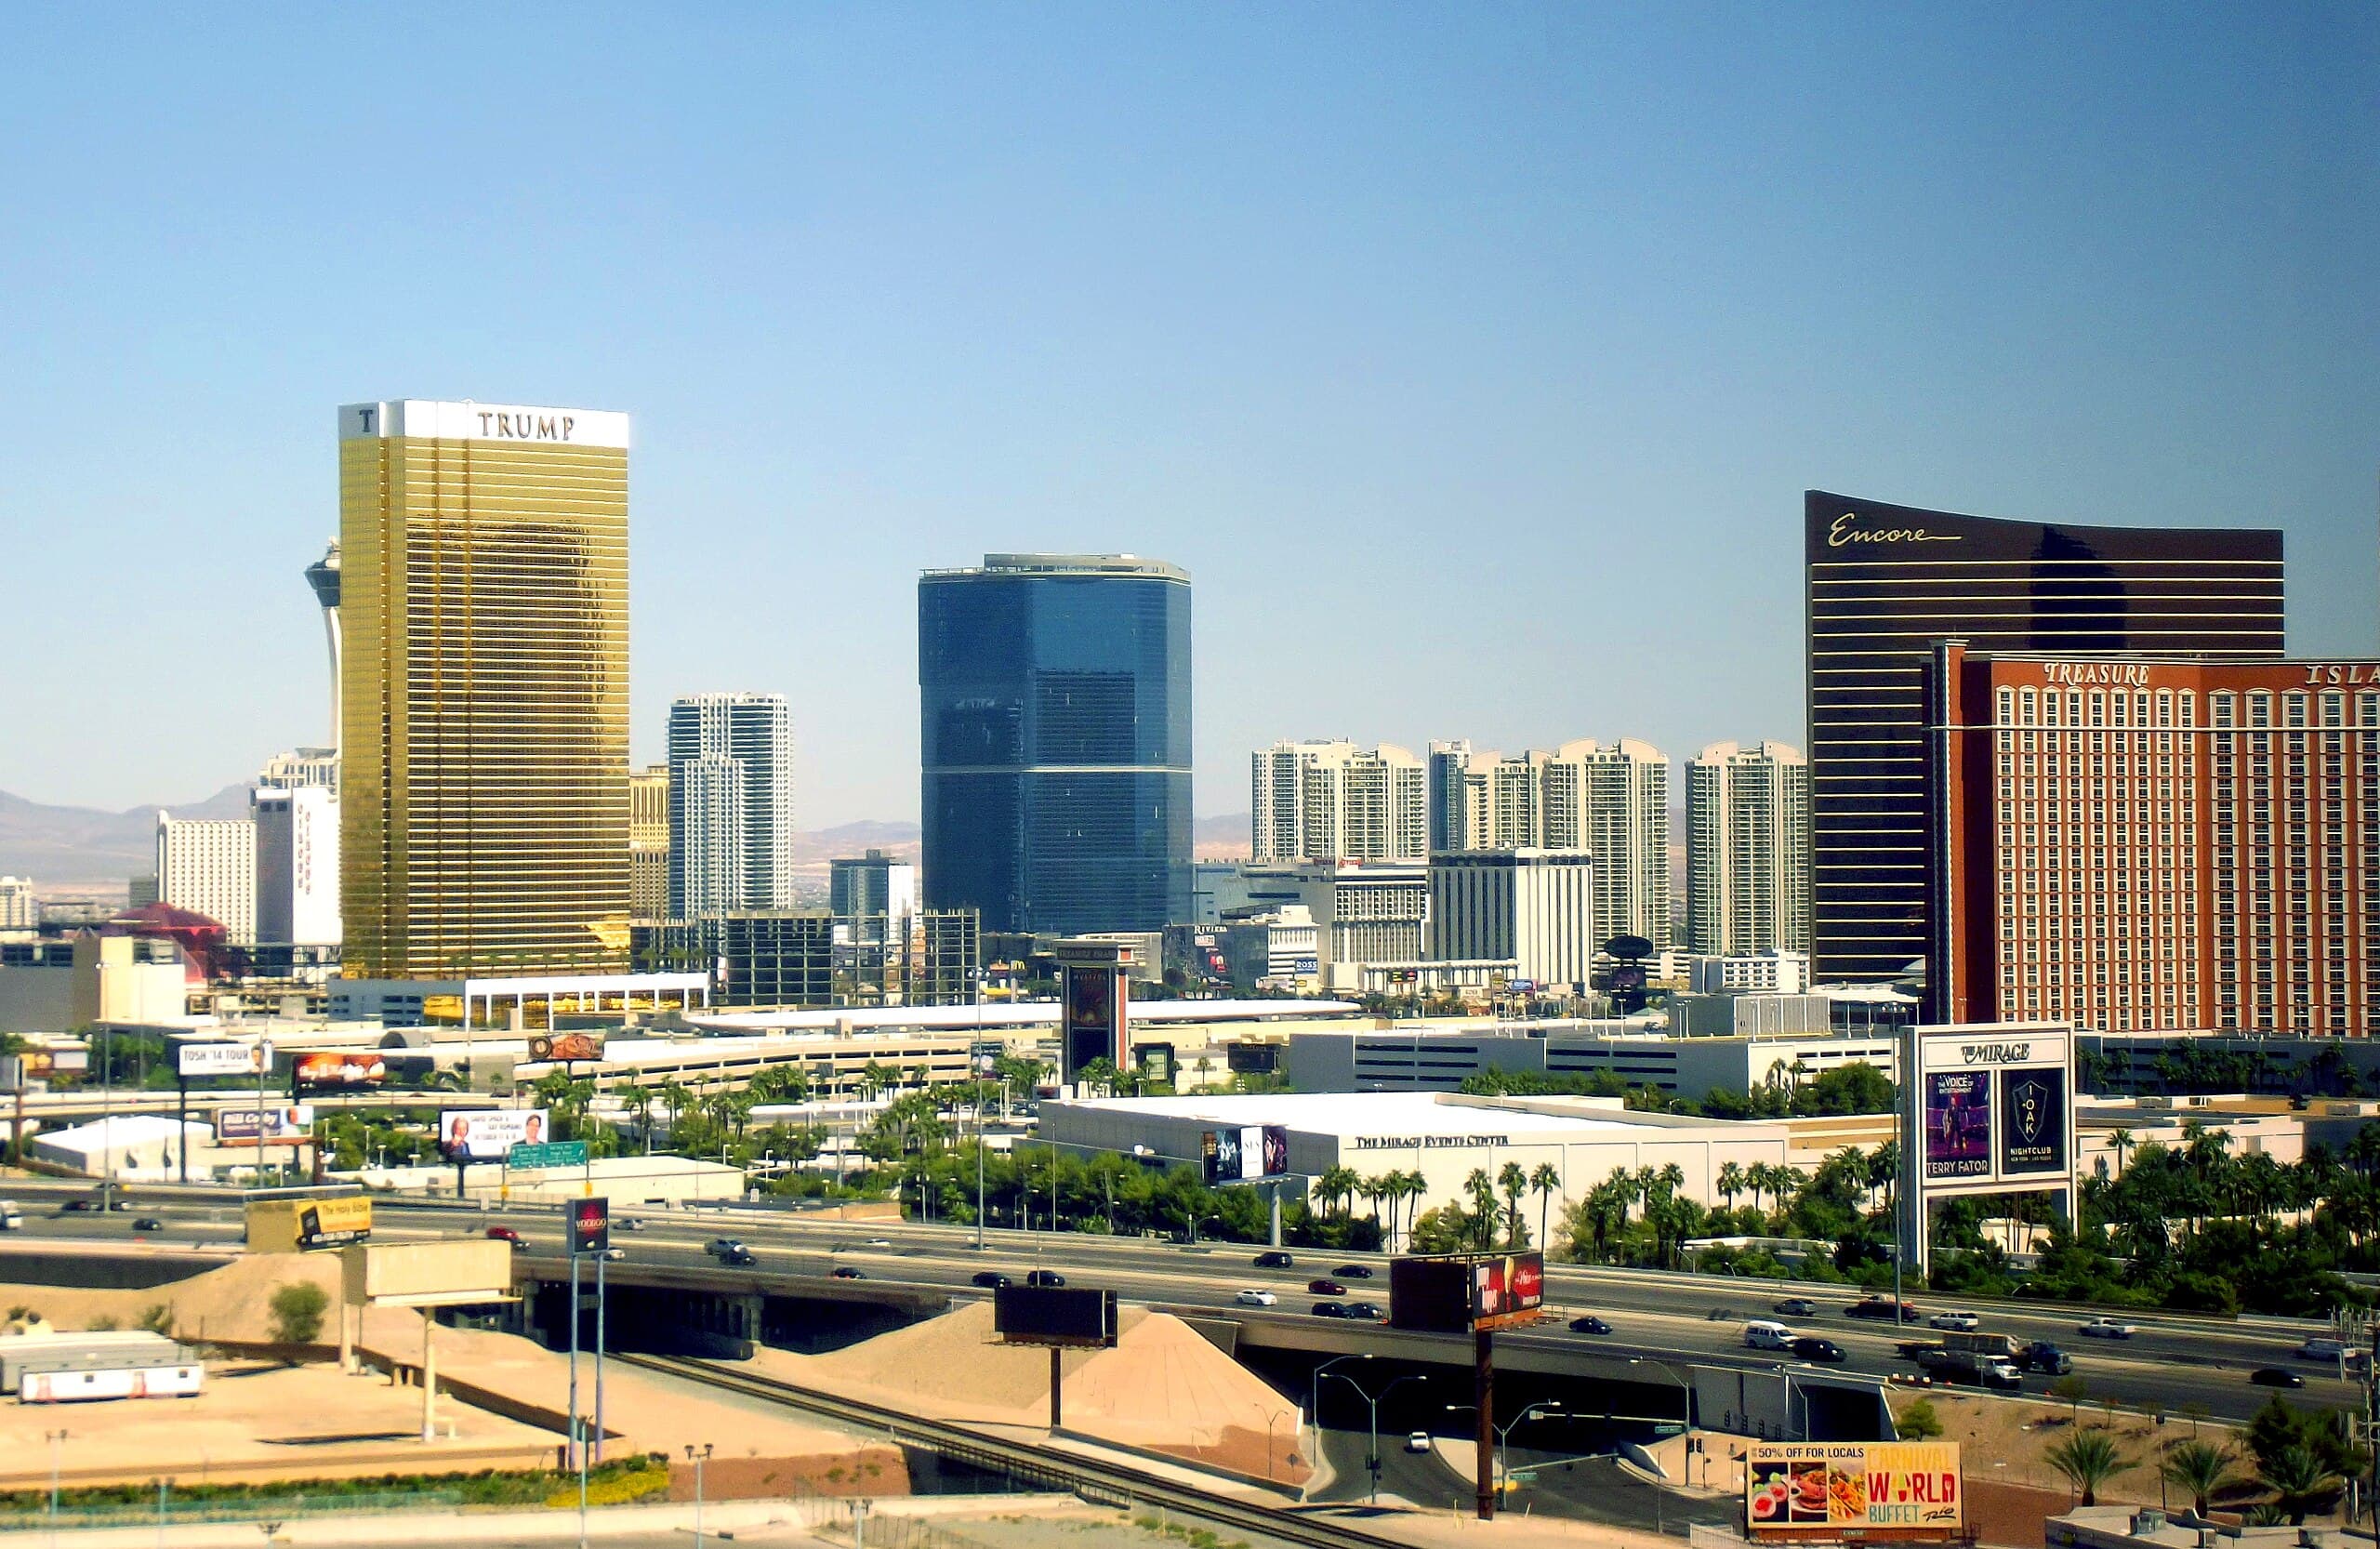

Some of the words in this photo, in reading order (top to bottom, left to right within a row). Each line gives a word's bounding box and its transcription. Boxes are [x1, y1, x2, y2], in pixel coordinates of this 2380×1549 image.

[477, 411, 575, 441] TRUMP
[1828, 512, 1963, 547] Encore
[2044, 662, 2149, 686] TREASURE
[184, 1050, 206, 1061] TOSH
[226, 1049, 248, 1060] TOUR
[1965, 1043, 2030, 1064] MIRAGE
[1944, 1077, 1968, 1087] VOICE
[245, 1112, 278, 1126] Coby
[1355, 1136, 1378, 1148] THE
[1381, 1136, 1421, 1149] MIRAGE
[1424, 1135, 1465, 1148] EVENTS
[1466, 1134, 1509, 1147] CENTER
[2010, 1146, 2052, 1156] NIGHTCLUB
[1927, 1161, 1956, 1174] TERRY
[1958, 1159, 1989, 1172] FATOR
[1758, 1447, 1783, 1458] 50%
[1786, 1447, 1804, 1458] OFF
[1806, 1447, 1825, 1458] FOR
[1828, 1447, 1865, 1458] LOCALS
[1867, 1446, 1950, 1472] CARNIVAL
[1869, 1504, 1921, 1524] BUFFET
